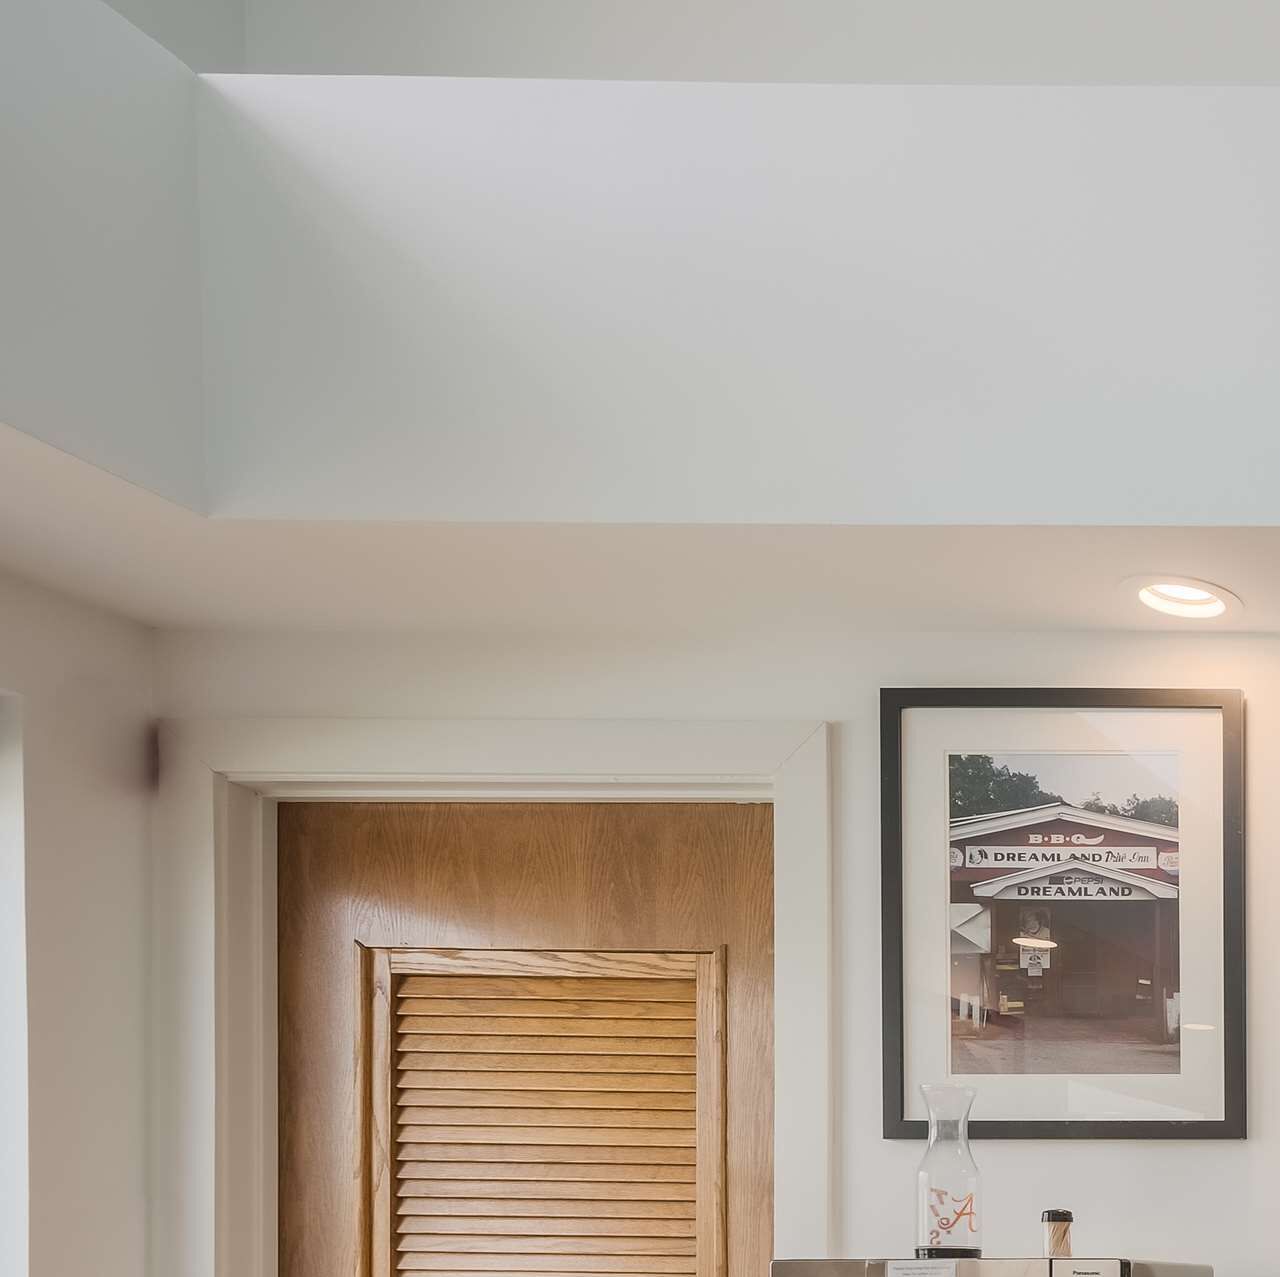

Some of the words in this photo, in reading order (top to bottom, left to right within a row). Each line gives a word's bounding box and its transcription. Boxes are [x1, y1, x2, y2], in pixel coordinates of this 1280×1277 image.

[994, 852, 1102, 863] DREAMLAND
[1074, 876, 1103, 885] PEPSI
[1017, 886, 1133, 897] DREAMLAND
